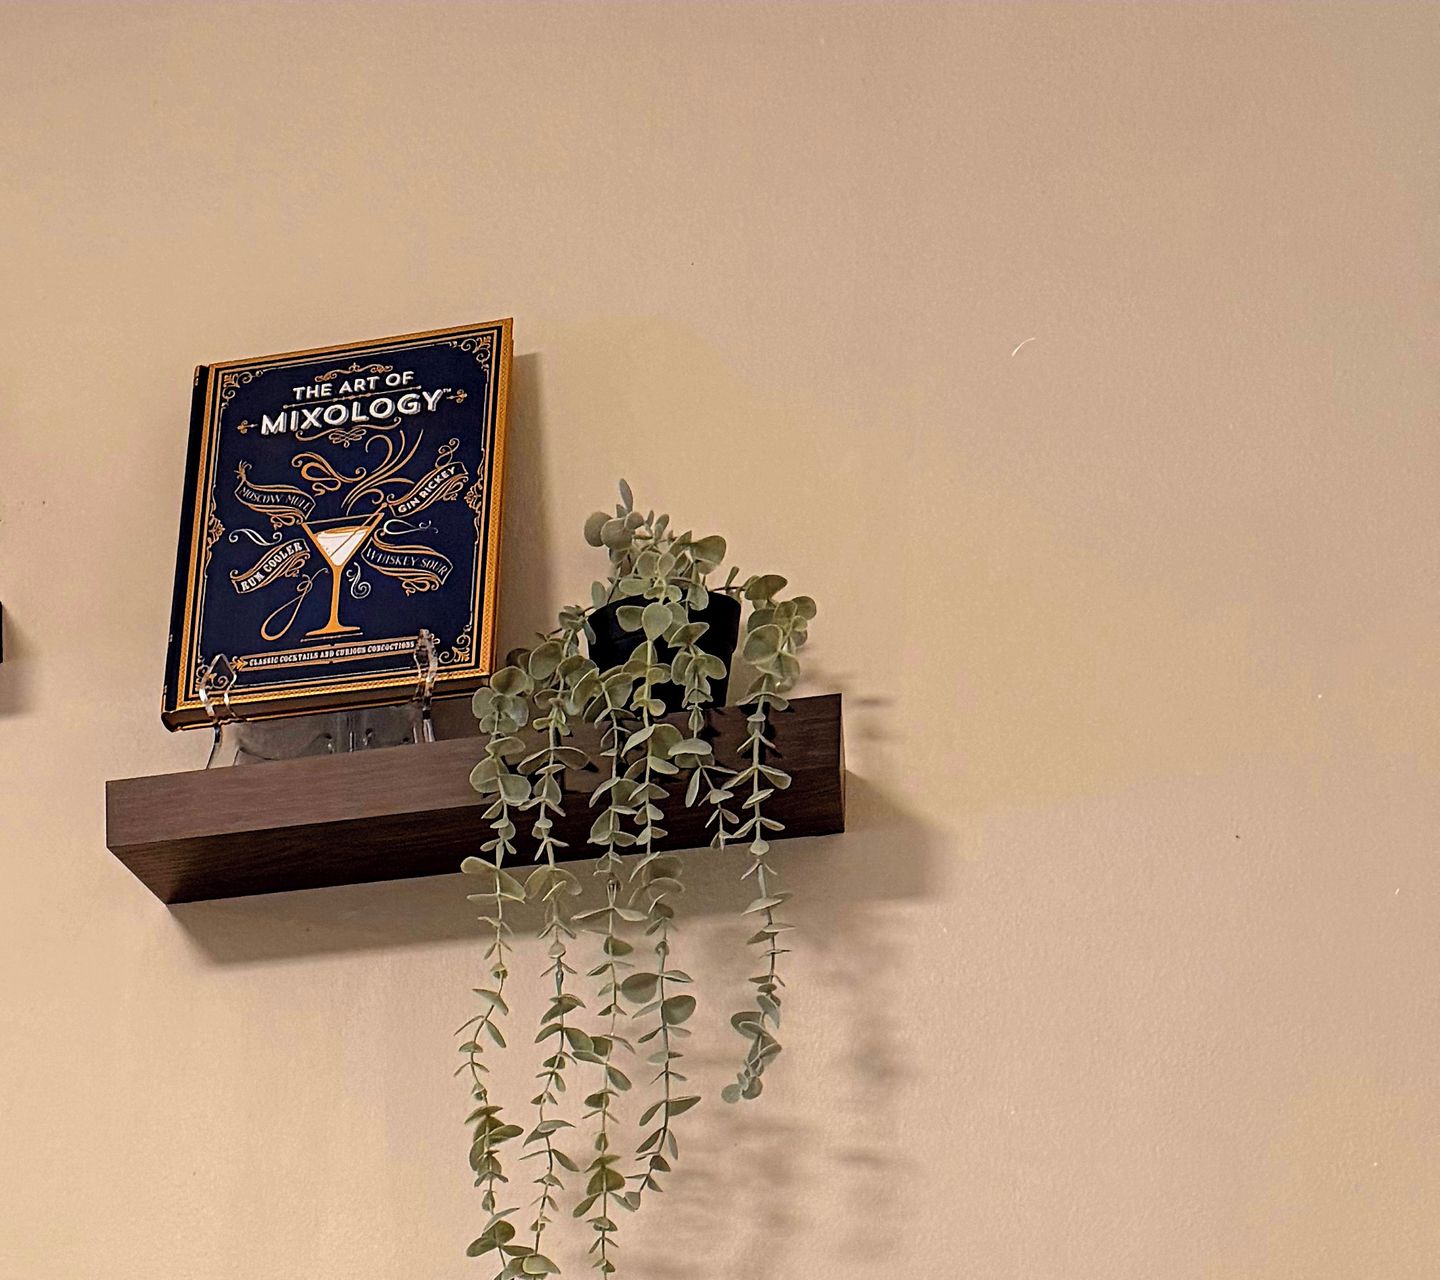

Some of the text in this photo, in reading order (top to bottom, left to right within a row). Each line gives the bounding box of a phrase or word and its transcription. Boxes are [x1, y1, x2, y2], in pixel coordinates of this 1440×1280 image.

[293, 371, 415, 400] THE ART OF
[238, 486, 313, 511] MOSCOW MULE
[398, 466, 456, 513] GIN RICKEY
[240, 542, 303, 592] RUM COOLER
[366, 548, 448, 576] WHISKEY SOUR
[249, 641, 415, 666] CLASSIC COCKTAILS AND CURIOUS CONCOCTIONS
